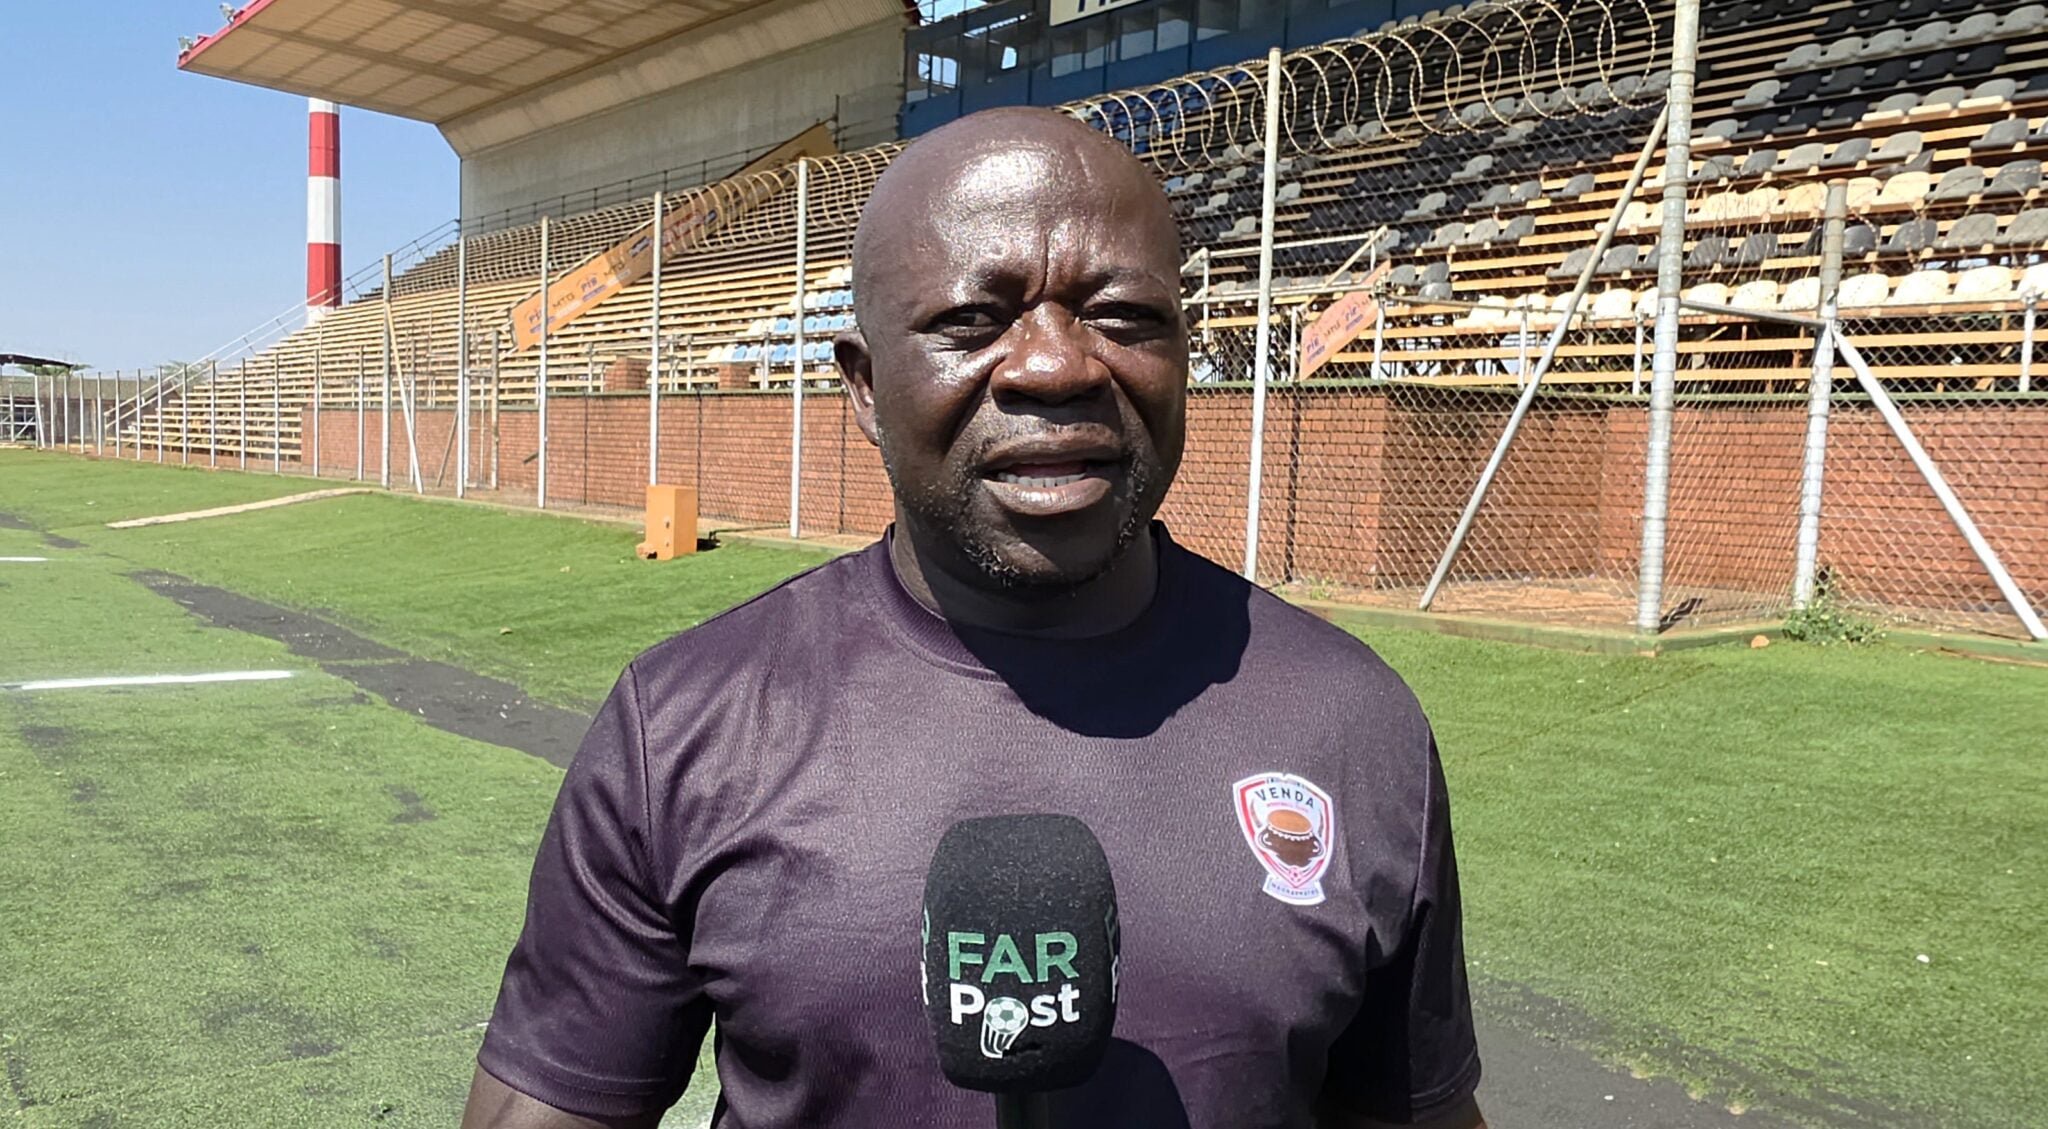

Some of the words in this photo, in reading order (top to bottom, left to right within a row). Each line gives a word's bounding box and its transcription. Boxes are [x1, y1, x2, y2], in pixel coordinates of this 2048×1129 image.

[1255, 787, 1315, 809] VENDA
[947, 931, 1080, 984] FAR
[949, 983, 1080, 1034] Post
